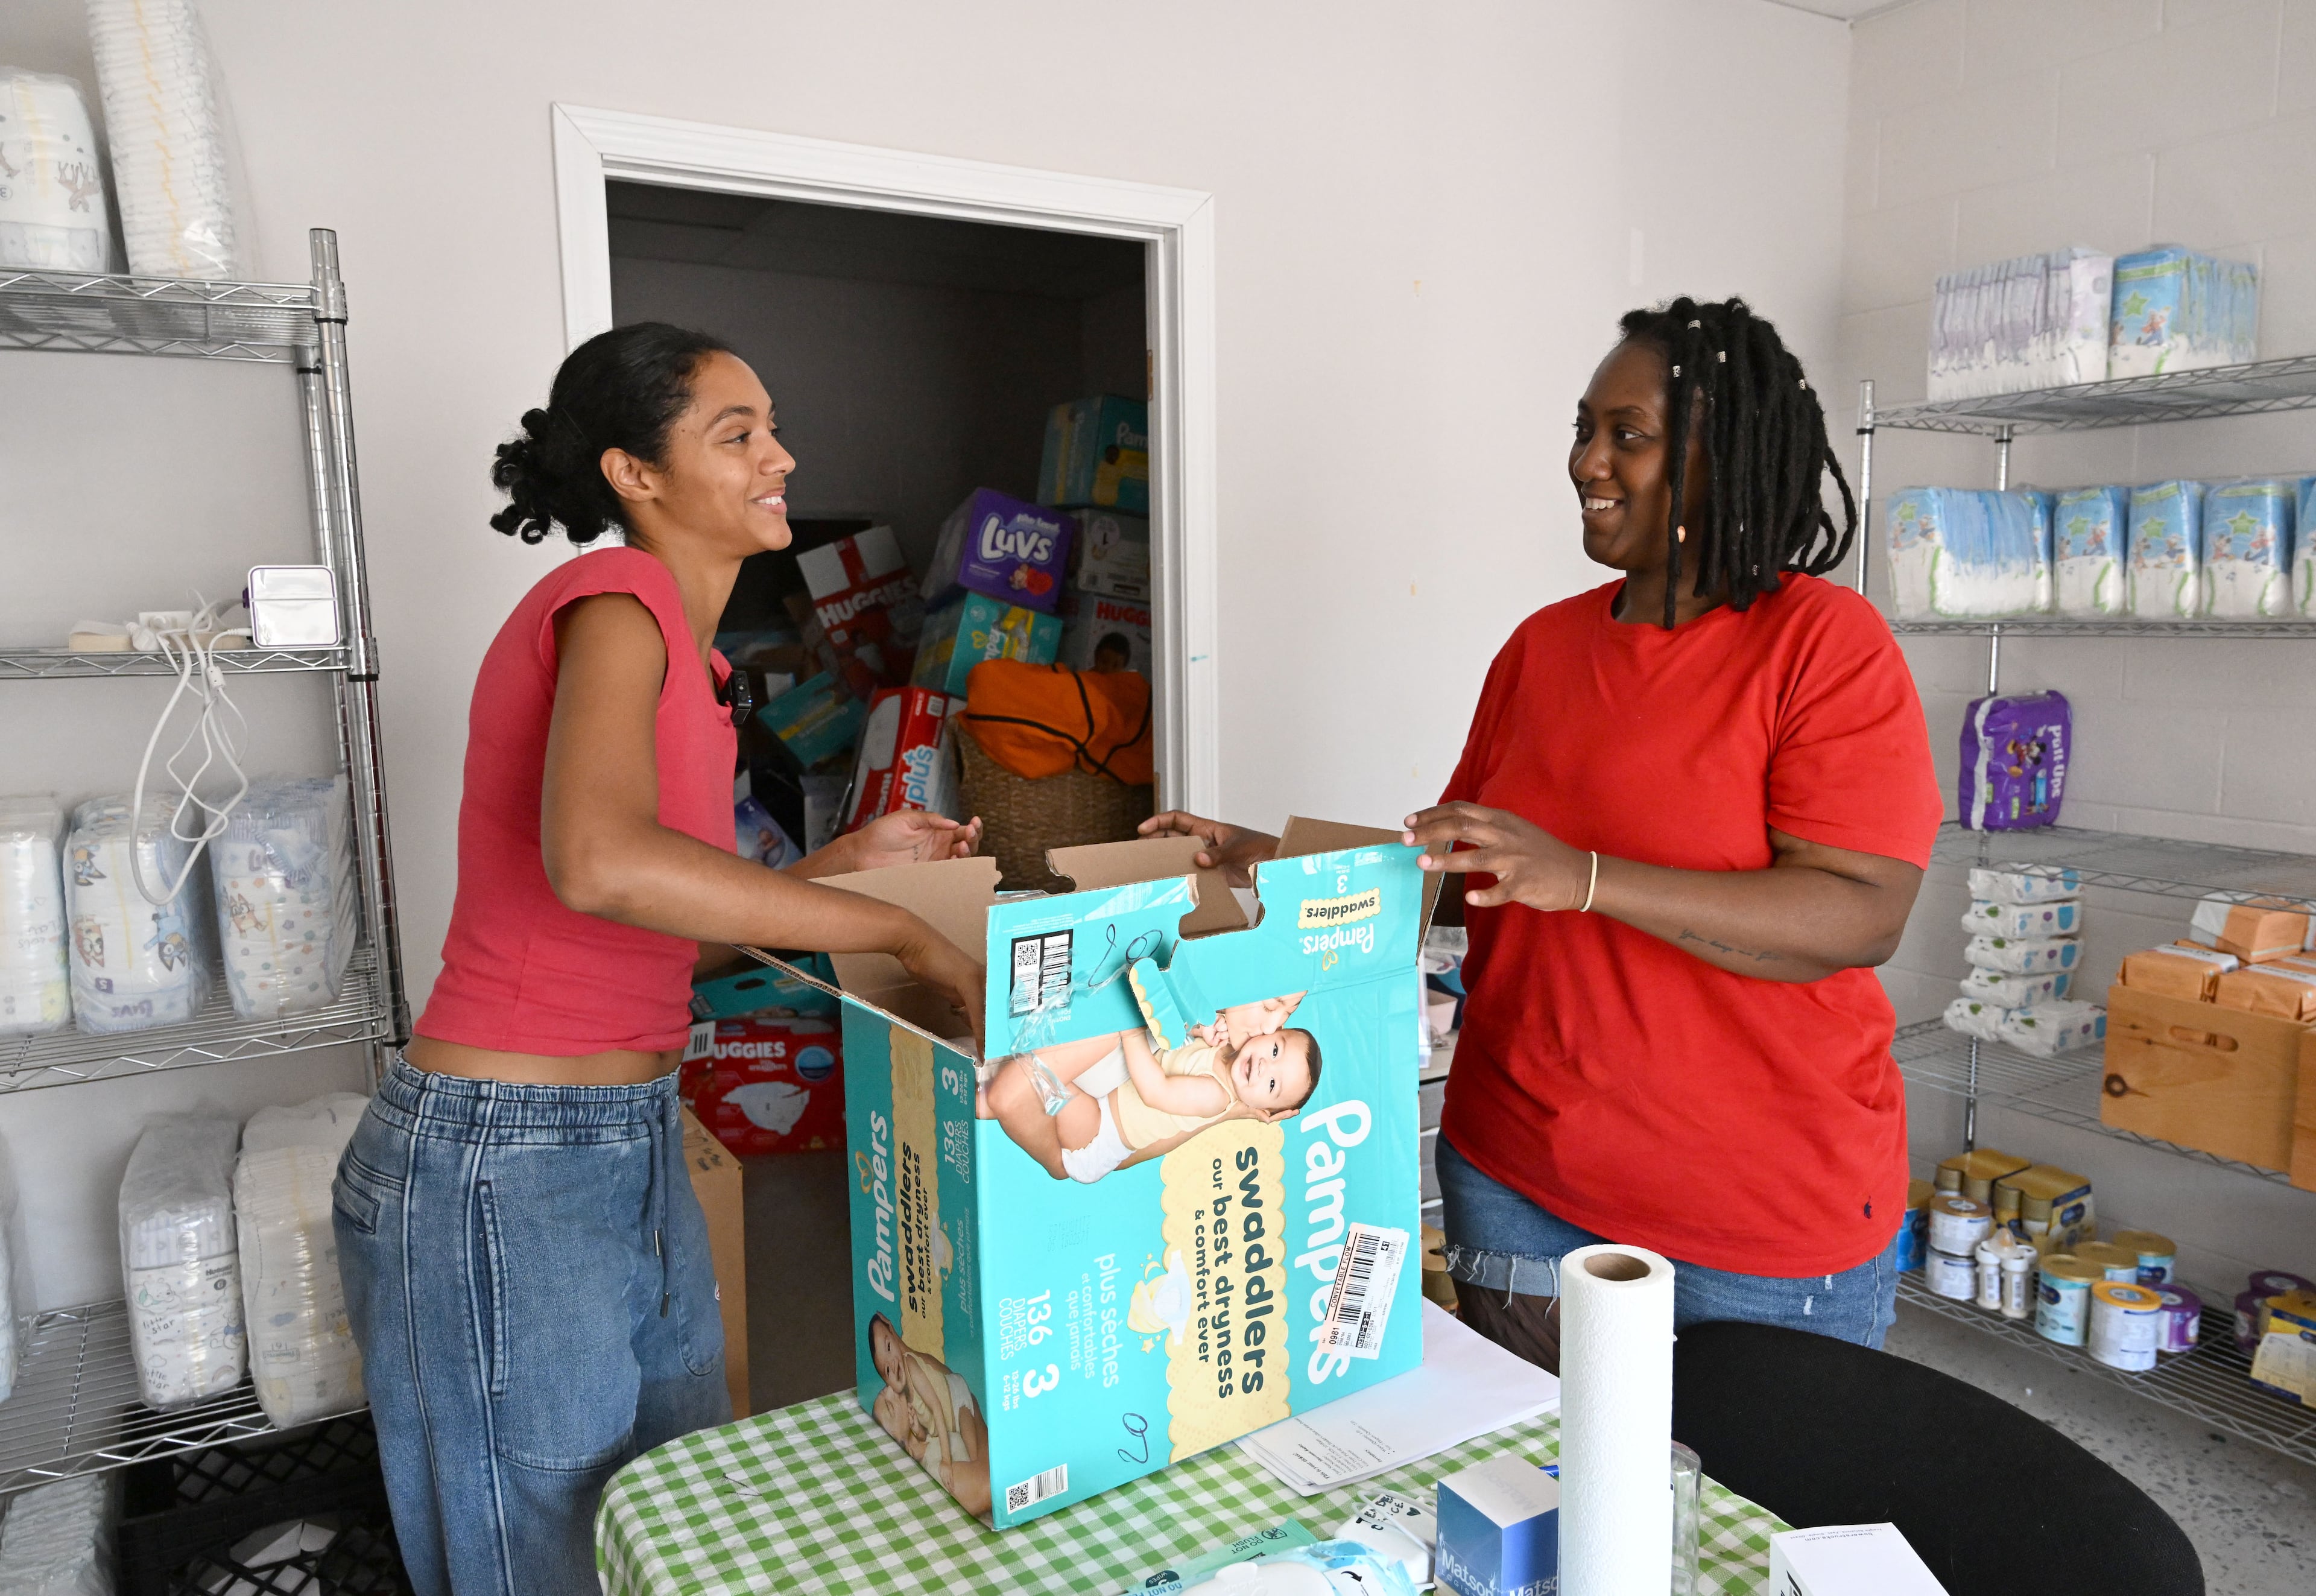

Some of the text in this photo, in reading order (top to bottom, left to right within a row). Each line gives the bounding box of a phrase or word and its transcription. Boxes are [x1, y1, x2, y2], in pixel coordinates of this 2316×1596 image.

[1096, 602, 1150, 626] HUGG
[1306, 896, 1376, 919] swaddlers
[1337, 875, 1347, 893] 3
[1302, 923, 1374, 955] Pampers
[713, 1040, 786, 1060] UGGIES
[942, 1066, 958, 1096] 3
[943, 1121, 956, 1164] 136
[954, 1119, 963, 1175] DIAPERS
[961, 1119, 970, 1184] COUCHES
[868, 1110, 895, 1303] Pampers
[913, 1154, 922, 1237] dryness
[897, 1141, 919, 1313] swaddlers
[1294, 1100, 1372, 1385] Pampes
[917, 1246, 925, 1291] best
[1195, 1210, 1210, 1363] & comfort ever
[1212, 1157, 1234, 1399] our best dryness
[1236, 1146, 1274, 1395] swaddlers
[1331, 1245, 1352, 1308] CONVEYABLE FLOW
[959, 1279, 969, 1314] plus
[1027, 1289, 1051, 1346] 136
[1093, 1253, 1120, 1389] plus sèches
[998, 1297, 1014, 1361] COUCHES
[1013, 1297, 1027, 1350] DIAPERS
[1066, 1290, 1082, 1371] que jamais
[1081, 1273, 1095, 1379] et confortables
[1329, 1327, 1340, 1345] 0981
[1022, 1363, 1060, 1399] 3
[1231, 1544, 1248, 1554] NOT
[1233, 1536, 1259, 1548] FLUSH
[1148, 1572, 1168, 1584] WIPES
[1442, 1550, 1496, 1596] Matson
[1510, 1576, 1557, 1596] Matso
